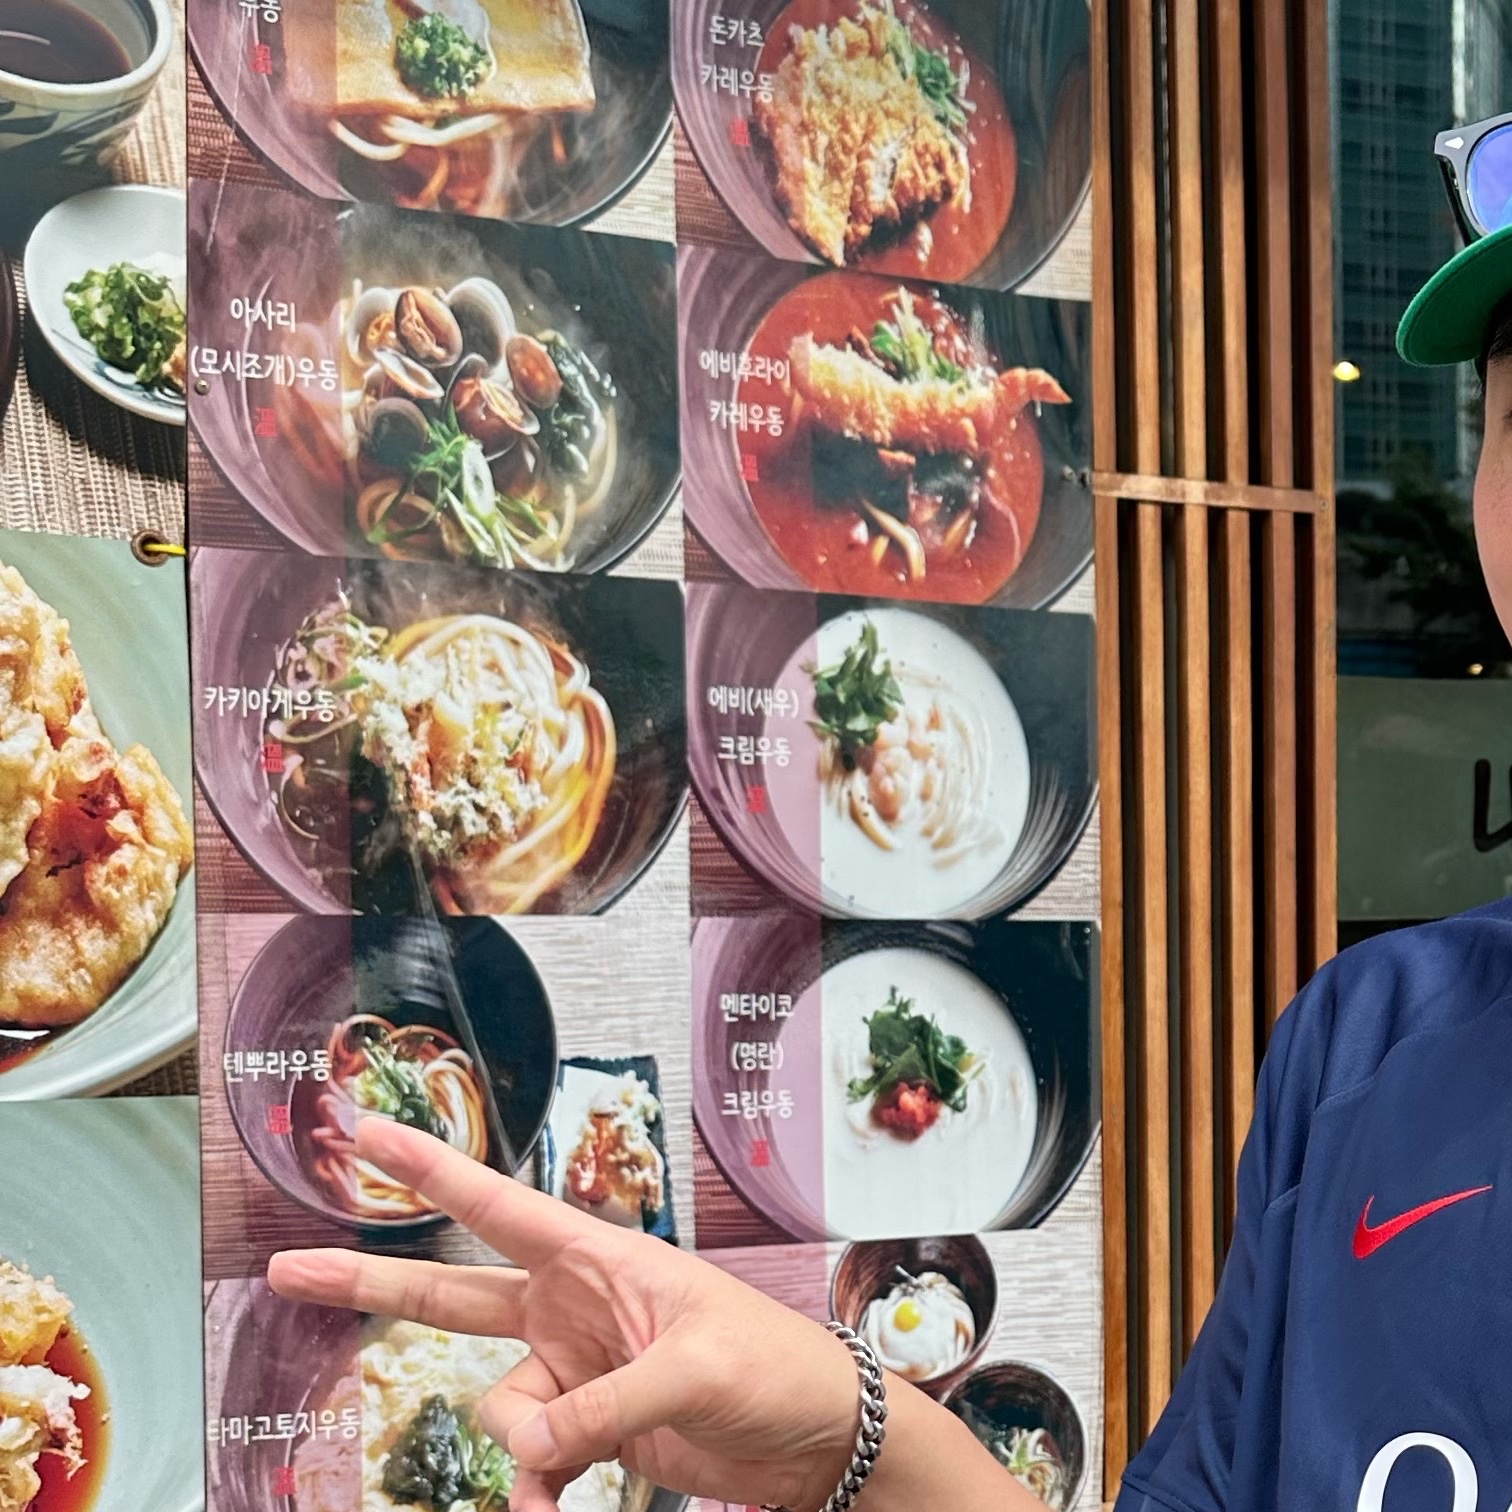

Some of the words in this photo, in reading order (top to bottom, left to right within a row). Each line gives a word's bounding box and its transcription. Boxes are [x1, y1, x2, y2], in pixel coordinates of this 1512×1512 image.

[709, 15, 765, 48] 돈카츠
[701, 64, 775, 103] 카레우동
[231, 297, 296, 333] 아사리
[190, 346, 339, 391] (모시조개)우동
[699, 349, 791, 390] 에비후라이
[709, 400, 784, 437] 카레우동
[204, 686, 337, 723] 카키아게우동
[708, 685, 799, 718] 에비(새우)
[717, 735, 792, 767] 크림우동
[720, 992, 795, 1023] 멘타이코
[223, 1049, 333, 1083] 텐뿌라우동
[731, 1041, 785, 1071] (명란)
[721, 1089, 795, 1120] 크림우동
[206, 1408, 361, 1447] 타마고토지우동
